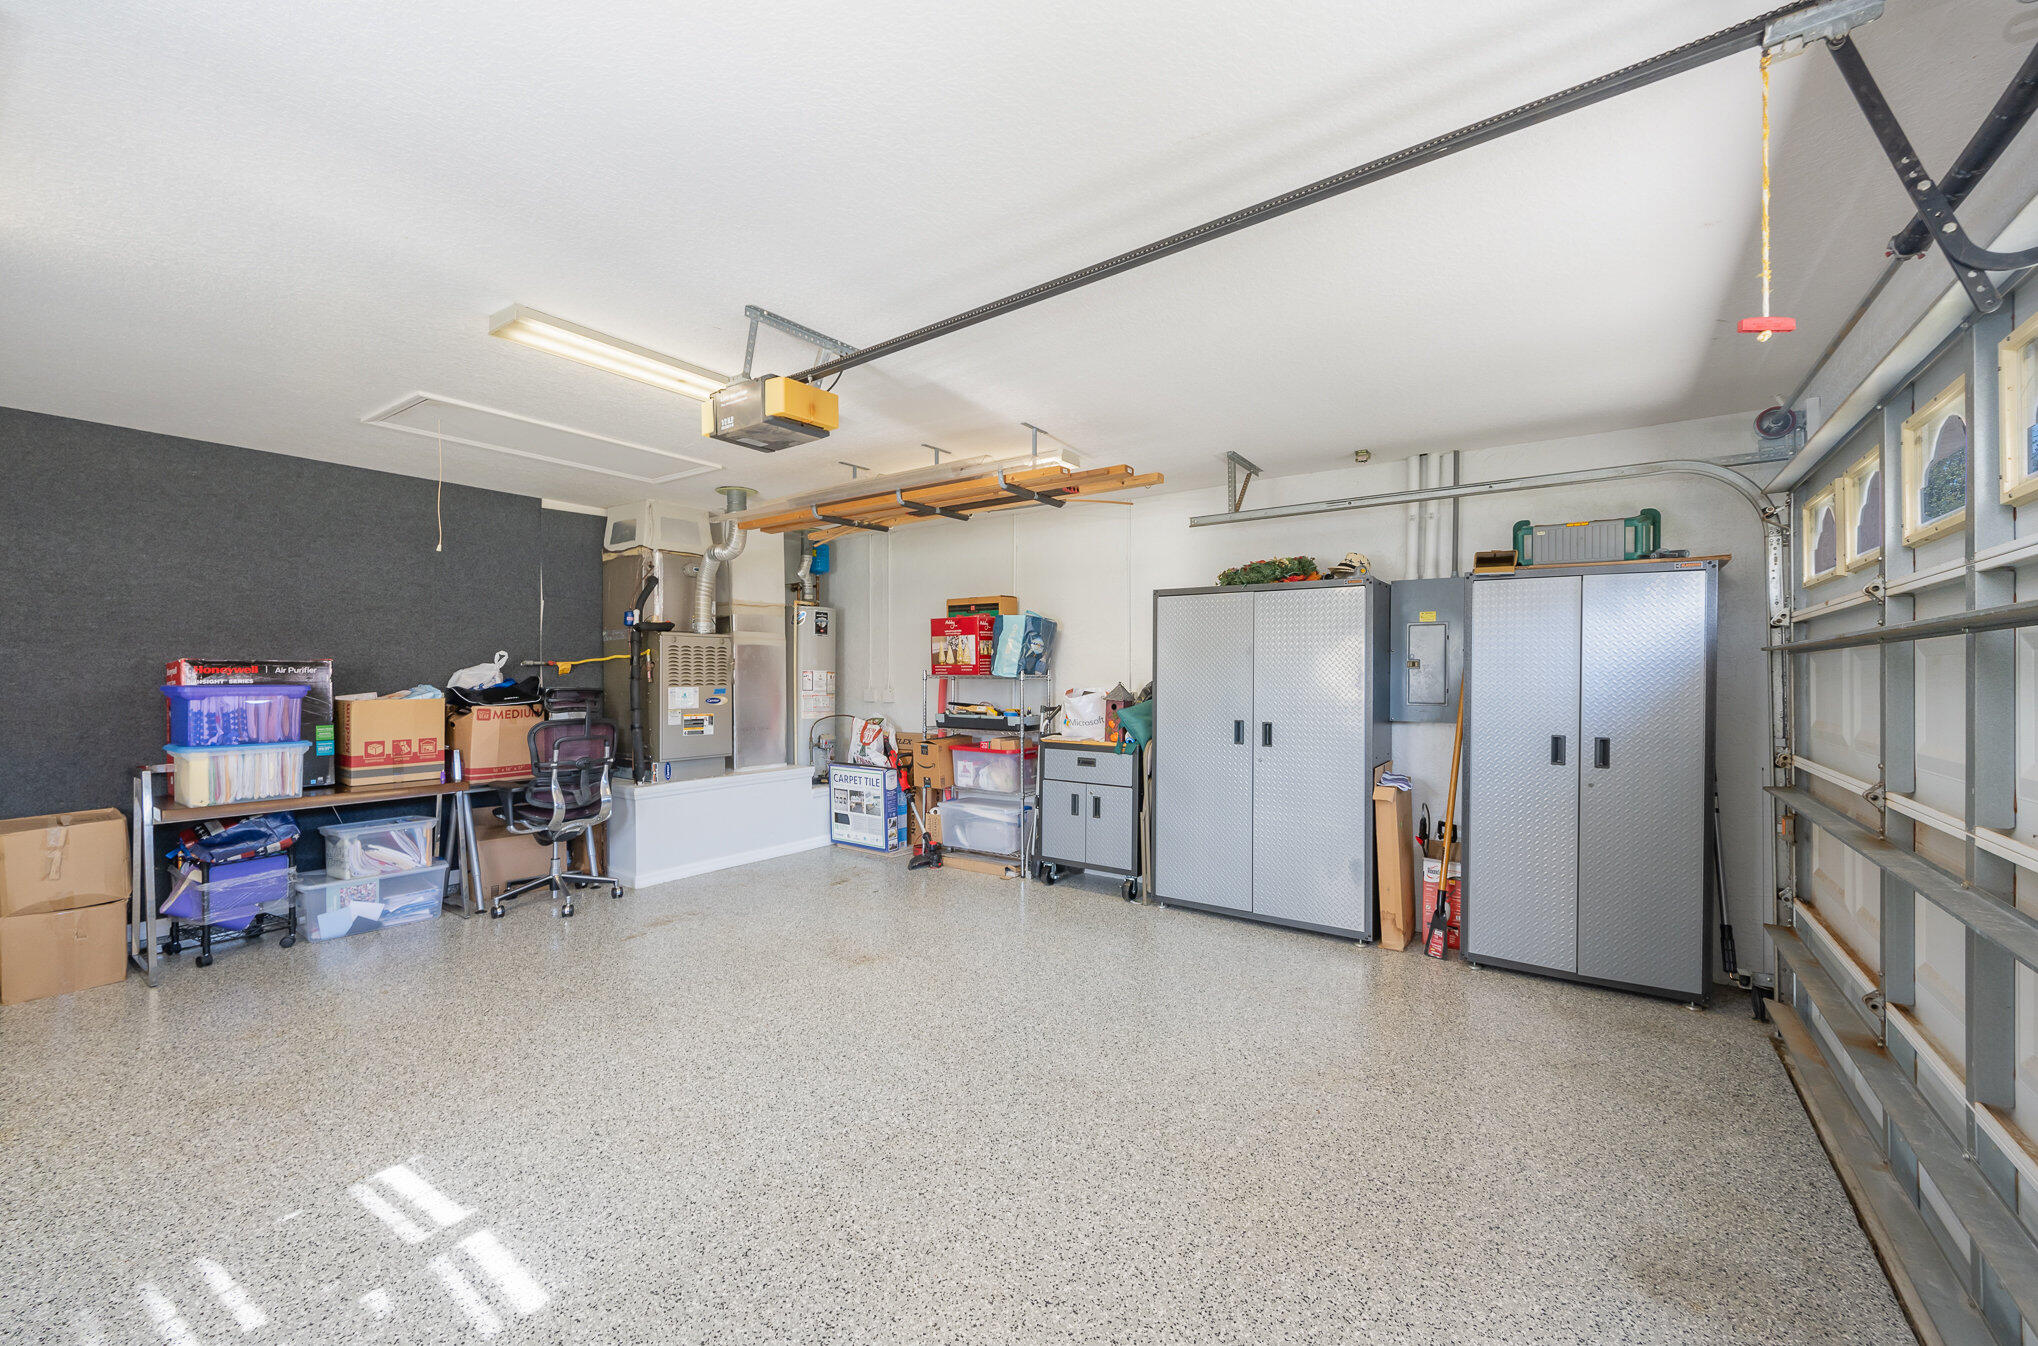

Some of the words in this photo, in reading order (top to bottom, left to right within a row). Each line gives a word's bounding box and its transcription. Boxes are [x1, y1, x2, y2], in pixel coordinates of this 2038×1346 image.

[193, 665, 259, 676] Honeywell
[275, 666, 286, 674] Air
[288, 666, 318, 674] Purifier
[1070, 716, 1105, 727] Microsoft
[833, 773, 863, 785] CARPET
[864, 776, 880, 788] TILE
